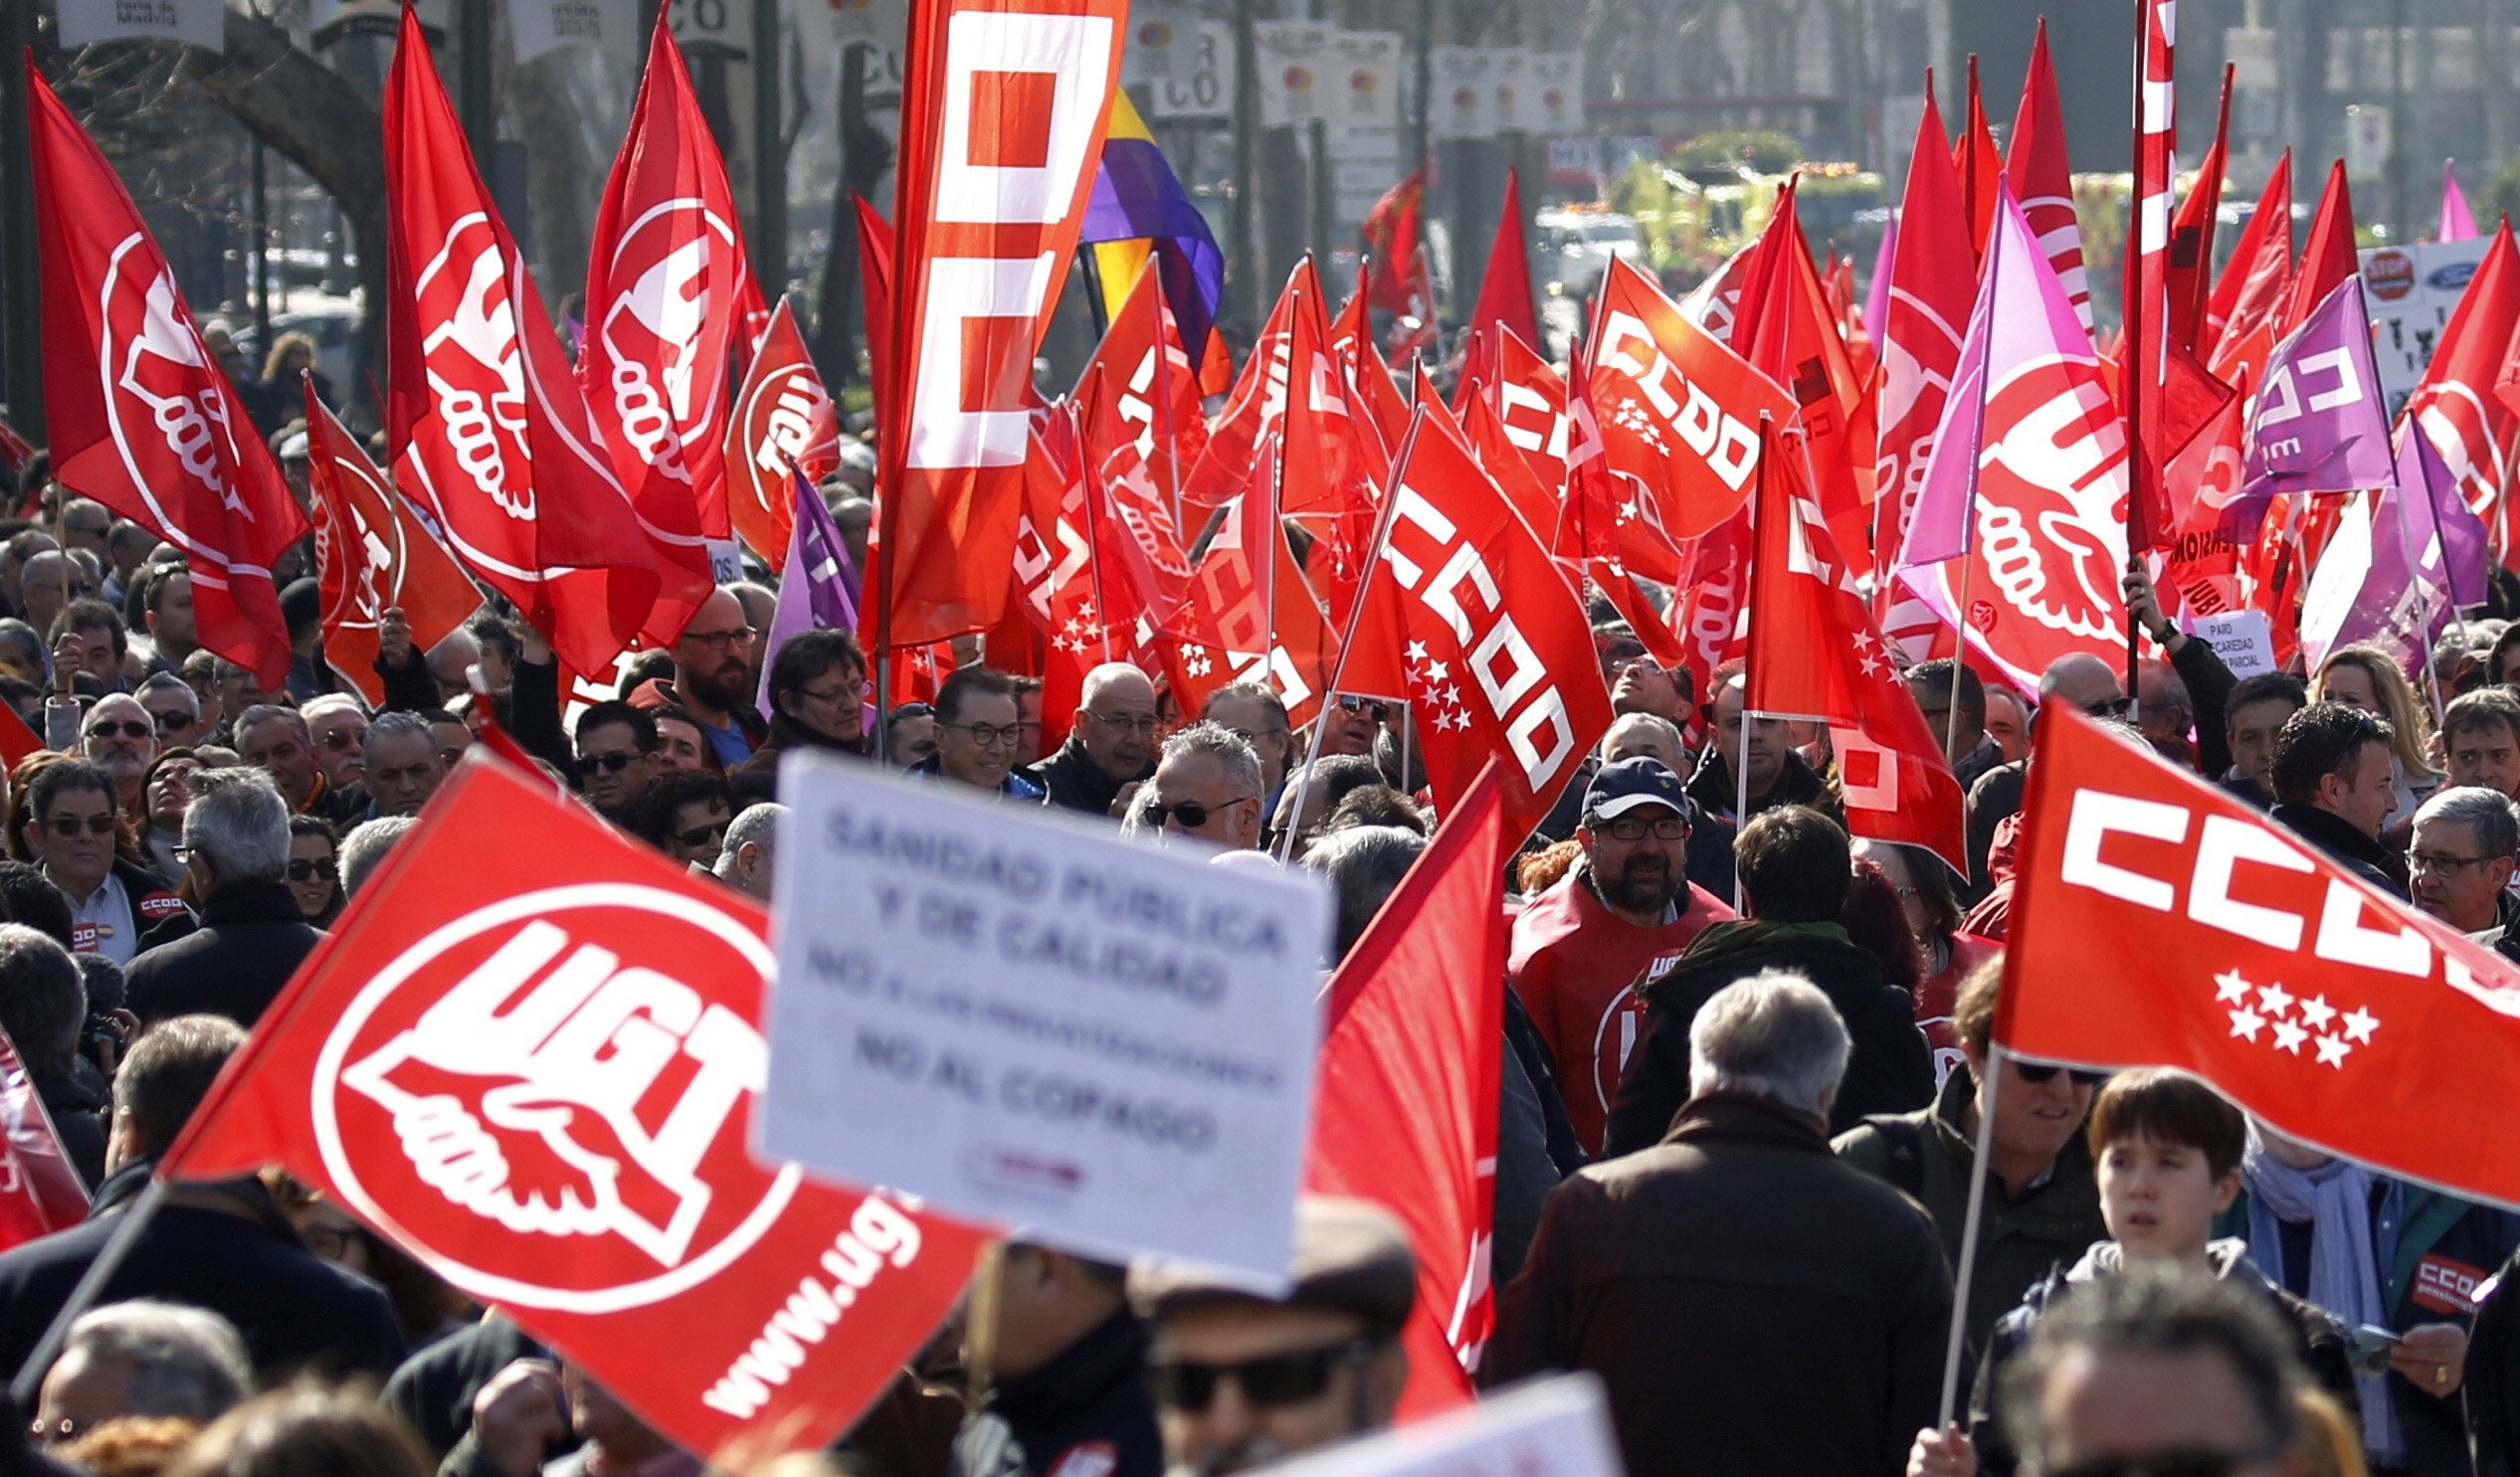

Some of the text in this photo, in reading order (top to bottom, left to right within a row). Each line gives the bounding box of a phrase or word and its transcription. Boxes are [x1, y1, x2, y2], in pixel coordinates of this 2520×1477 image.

[1597, 309, 1761, 492] CCOO
[1380, 482, 1576, 795] CCOO
[2182, 578, 2230, 616] JUBI
[2210, 623, 2233, 638] PARO
[140, 897, 183, 911] CCOO
[828, 807, 1051, 905] SANIDAD
[807, 939, 877, 991] NO
[873, 883, 1230, 1008] Y DE CALIDAD
[412, 918, 772, 1190] UGT
[855, 1024, 1220, 1155] NO AL COPAGO
[701, 1183, 925, 1420] www.ug
[2419, 1261, 2483, 1299] CCO
